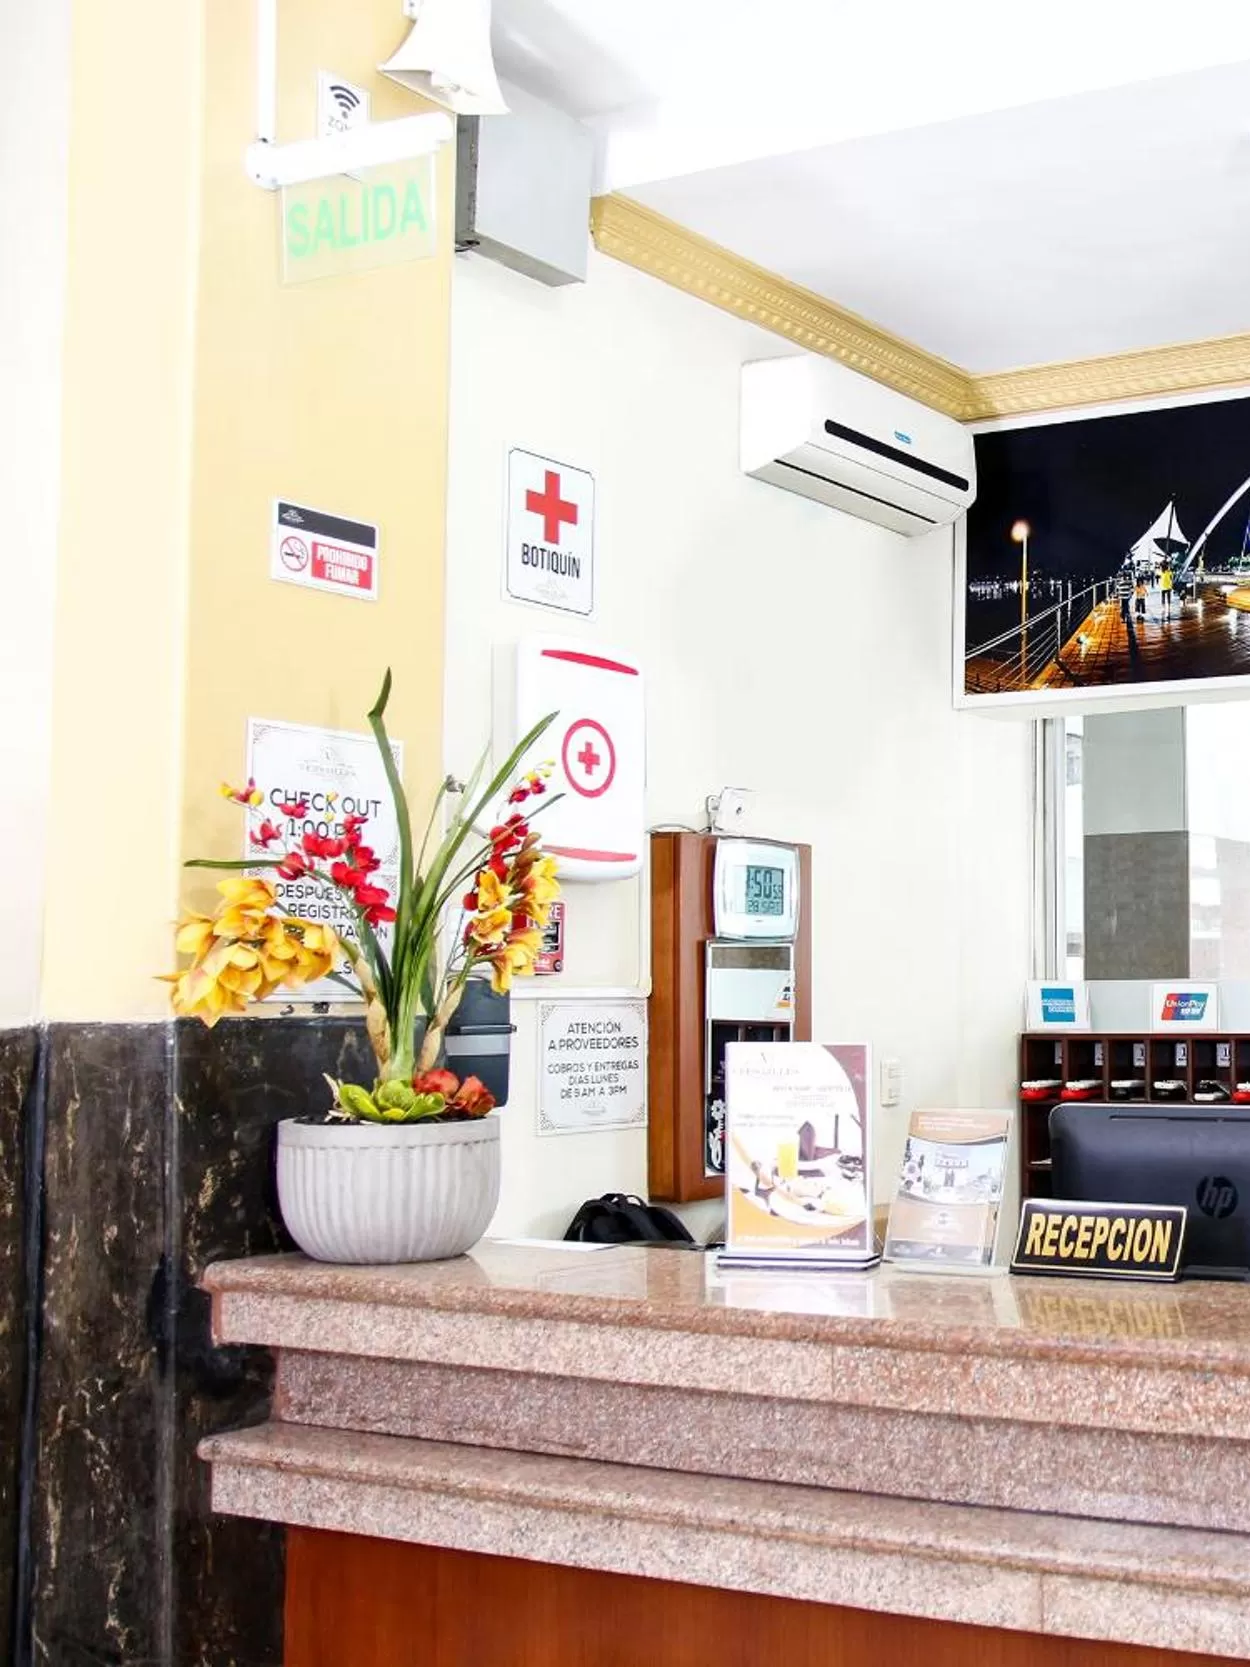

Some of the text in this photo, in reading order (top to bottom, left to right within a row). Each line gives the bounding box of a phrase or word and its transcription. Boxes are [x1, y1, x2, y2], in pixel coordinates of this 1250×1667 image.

[287, 178, 428, 258] SALIDA
[521, 542, 581, 579] BOTIQUÍN
[270, 788, 382, 817] CHECK OUT
[289, 818, 329, 839] 1:00
[548, 1036, 639, 1051] A PROVEEDORES
[547, 1060, 639, 1074] COBROS Y ENTREGAS
[591, 1073, 619, 1084] LUNES
[561, 1088, 572, 1099] DE
[582, 1087, 596, 1097] AM
[598, 1086, 605, 1096] A
[1200, 1176, 1234, 1219] hp
[1024, 1212, 1172, 1263] RECEPCION
